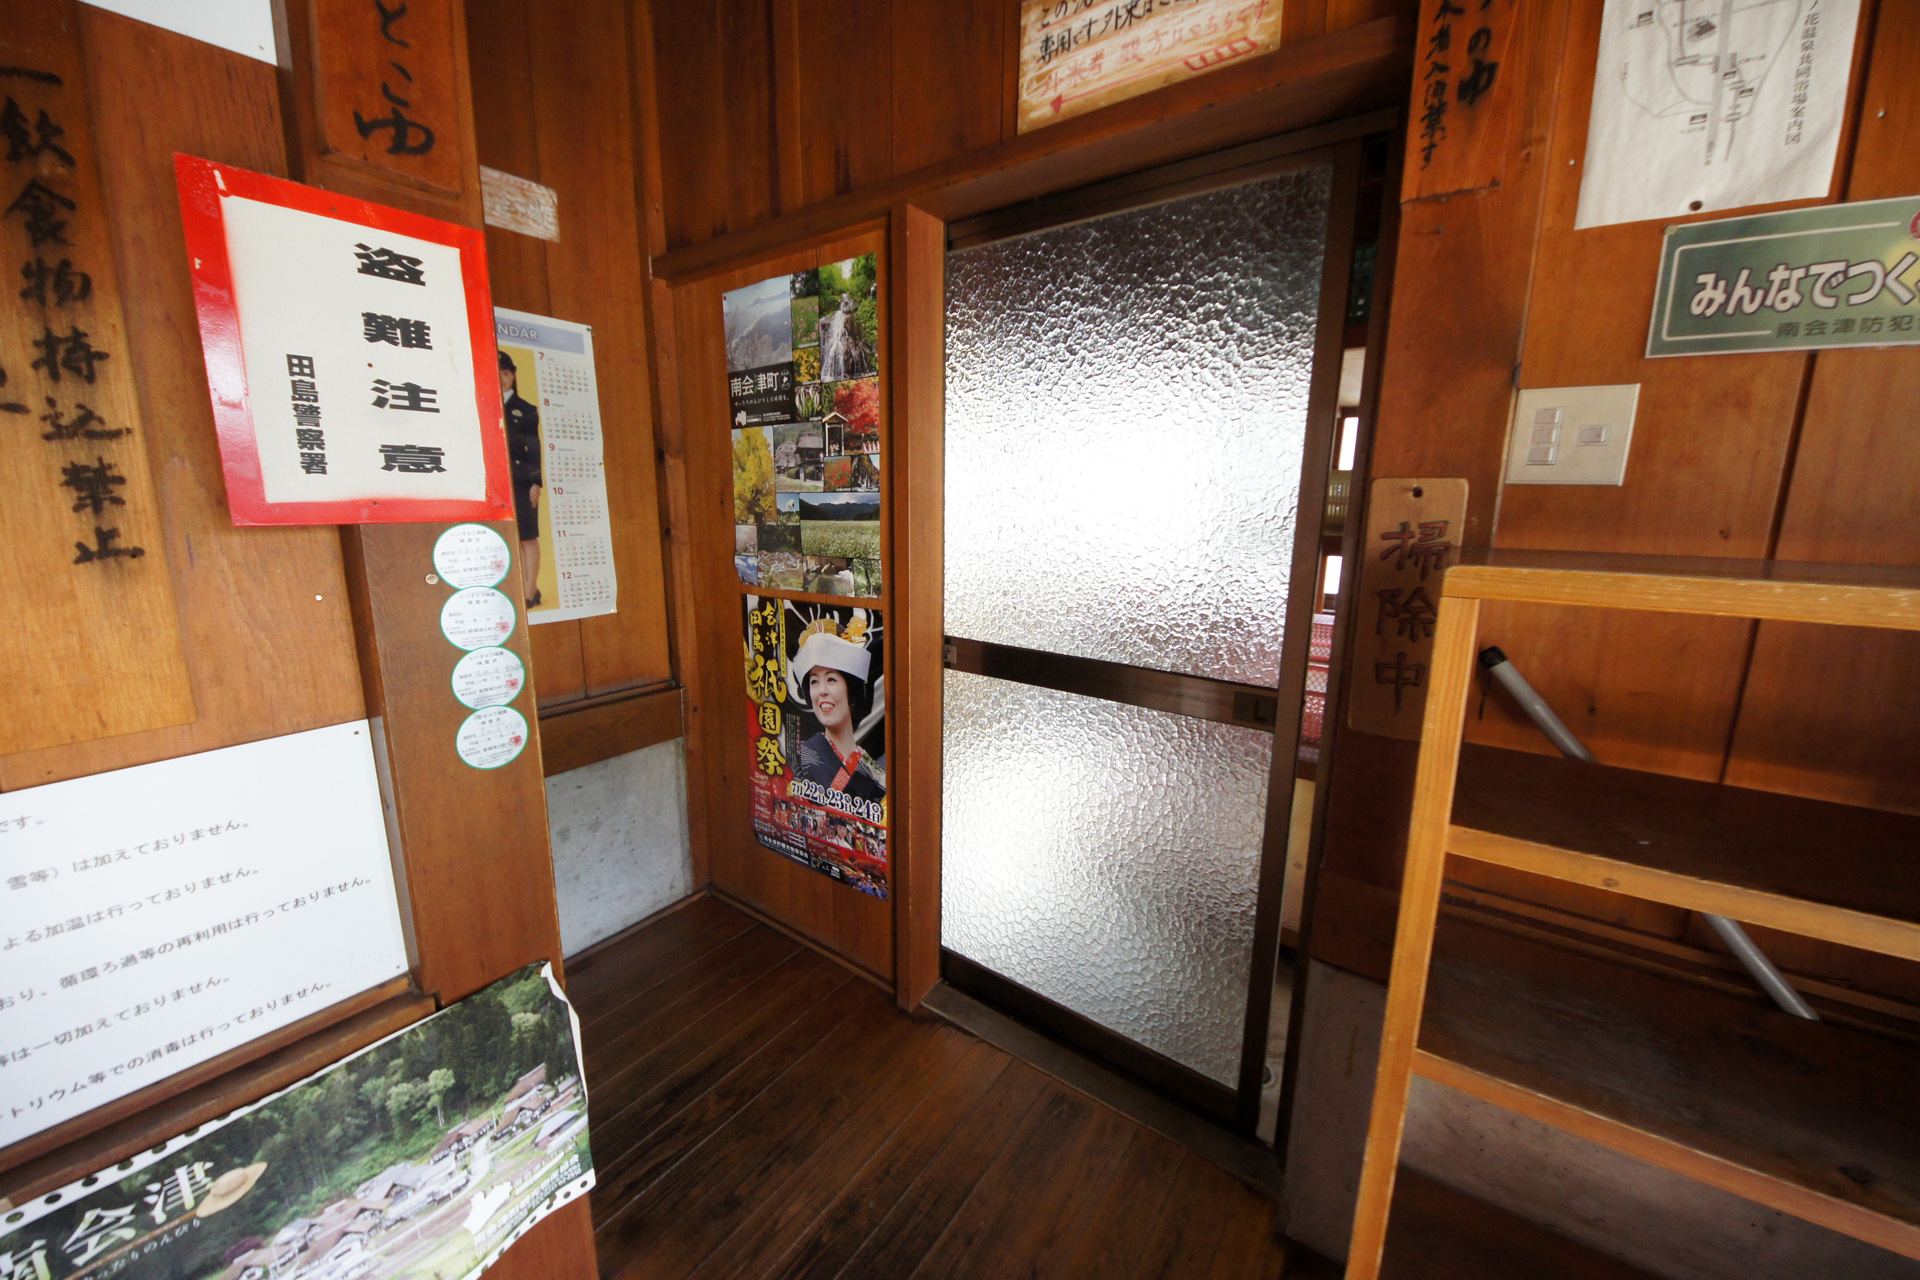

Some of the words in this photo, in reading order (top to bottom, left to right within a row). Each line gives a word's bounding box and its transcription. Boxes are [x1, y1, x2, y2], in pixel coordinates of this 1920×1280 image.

[1690, 251, 1920, 319] みんなでつく
[1776, 313, 1920, 338] 南会津防犯
[353, 242, 448, 474] 盗難注意
[730, 371, 779, 398] 南会津町
[286, 353, 328, 475] 田島警察署
[1373, 520, 1452, 714] 掃除中
[2, 867, 259, 951] よる加温は行っておりません。
[0, 981, 331, 1120] トリウム等での消毒は行っておりません。
